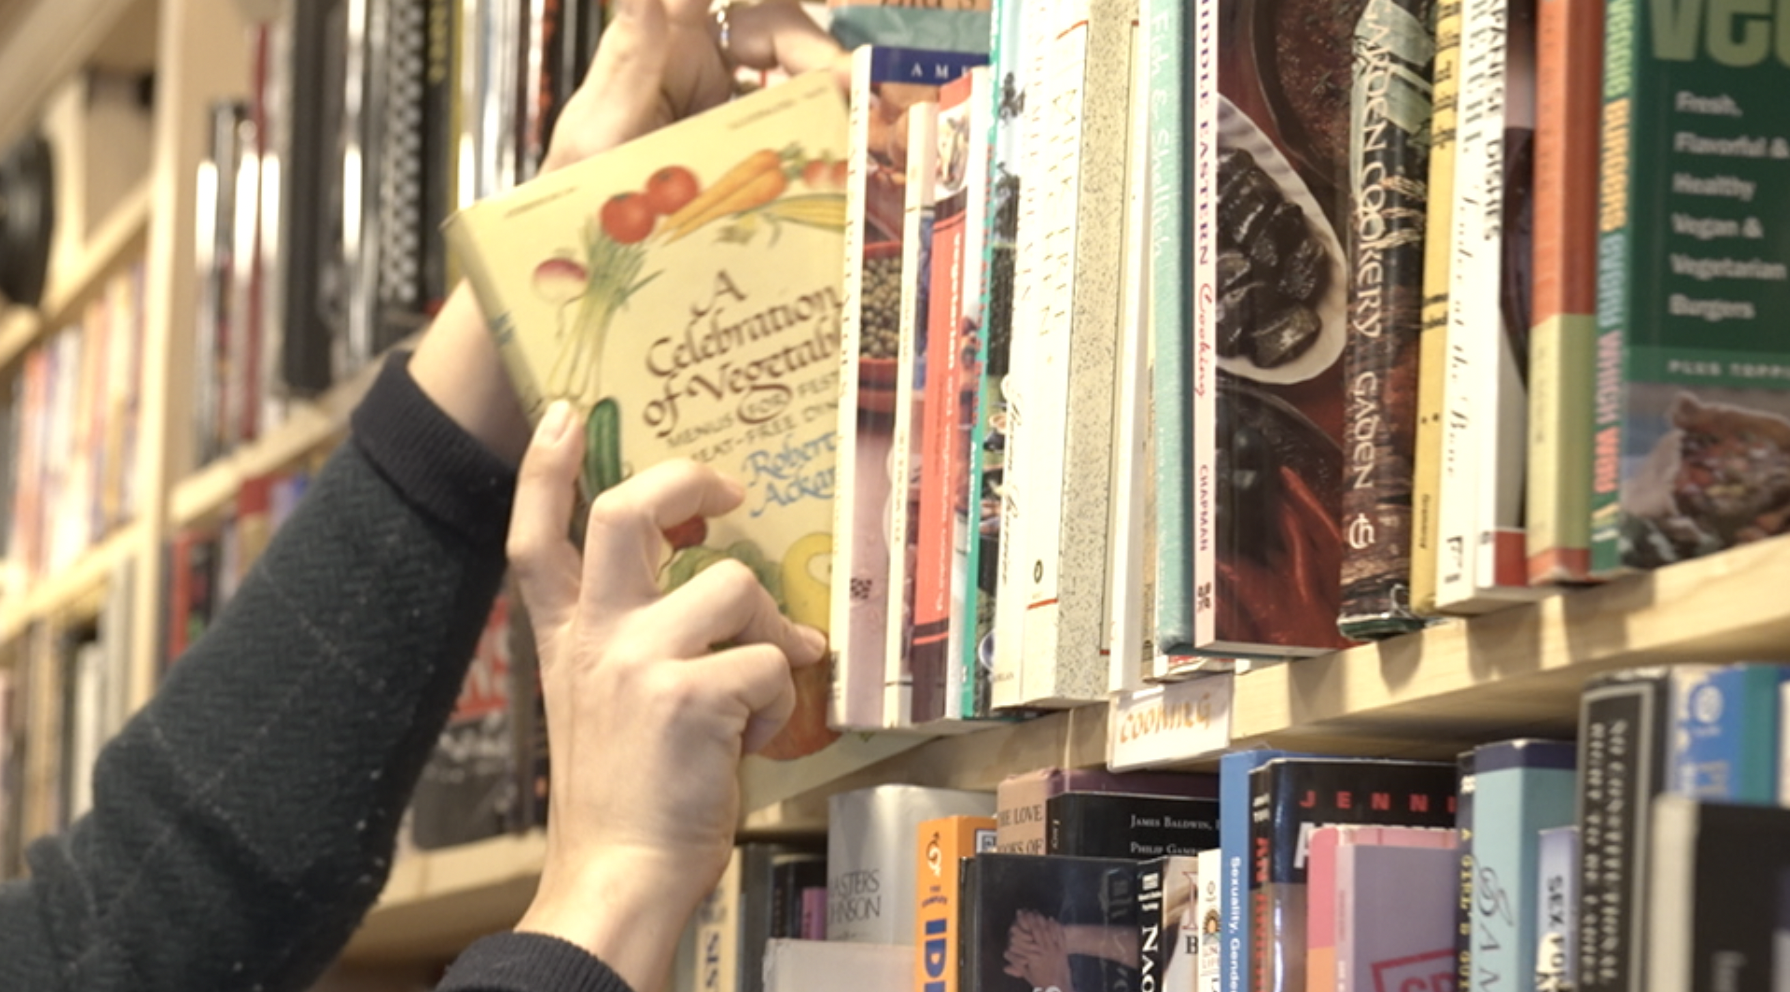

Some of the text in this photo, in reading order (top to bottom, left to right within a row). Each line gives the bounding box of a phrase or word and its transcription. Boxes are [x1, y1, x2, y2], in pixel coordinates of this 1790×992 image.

[1151, 11, 1172, 76] Fish
[1151, 130, 1172, 259] Shellfish
[1671, 173, 1757, 202] Healthy
[1352, 160, 1386, 339] COOKERY
[1670, 212, 1738, 241] Vegan
[690, 268, 750, 319] A
[1669, 254, 1788, 282] Vegetarian
[947, 232, 961, 369] vegetarian
[1667, 294, 1756, 322] Burgers
[643, 285, 844, 380] Celebration
[1194, 121, 1213, 553] EASTERN Cooking CHAPMAN
[640, 370, 682, 440] of
[665, 391, 789, 449] MENUS FOR
[1013, 806, 1044, 826] LOVE
[1130, 814, 1214, 837] JAMES BALDWIN,
[1130, 842, 1164, 862] PHILIP
[1228, 857, 1241, 934] Sexuality,
[1547, 874, 1566, 928] SEX
